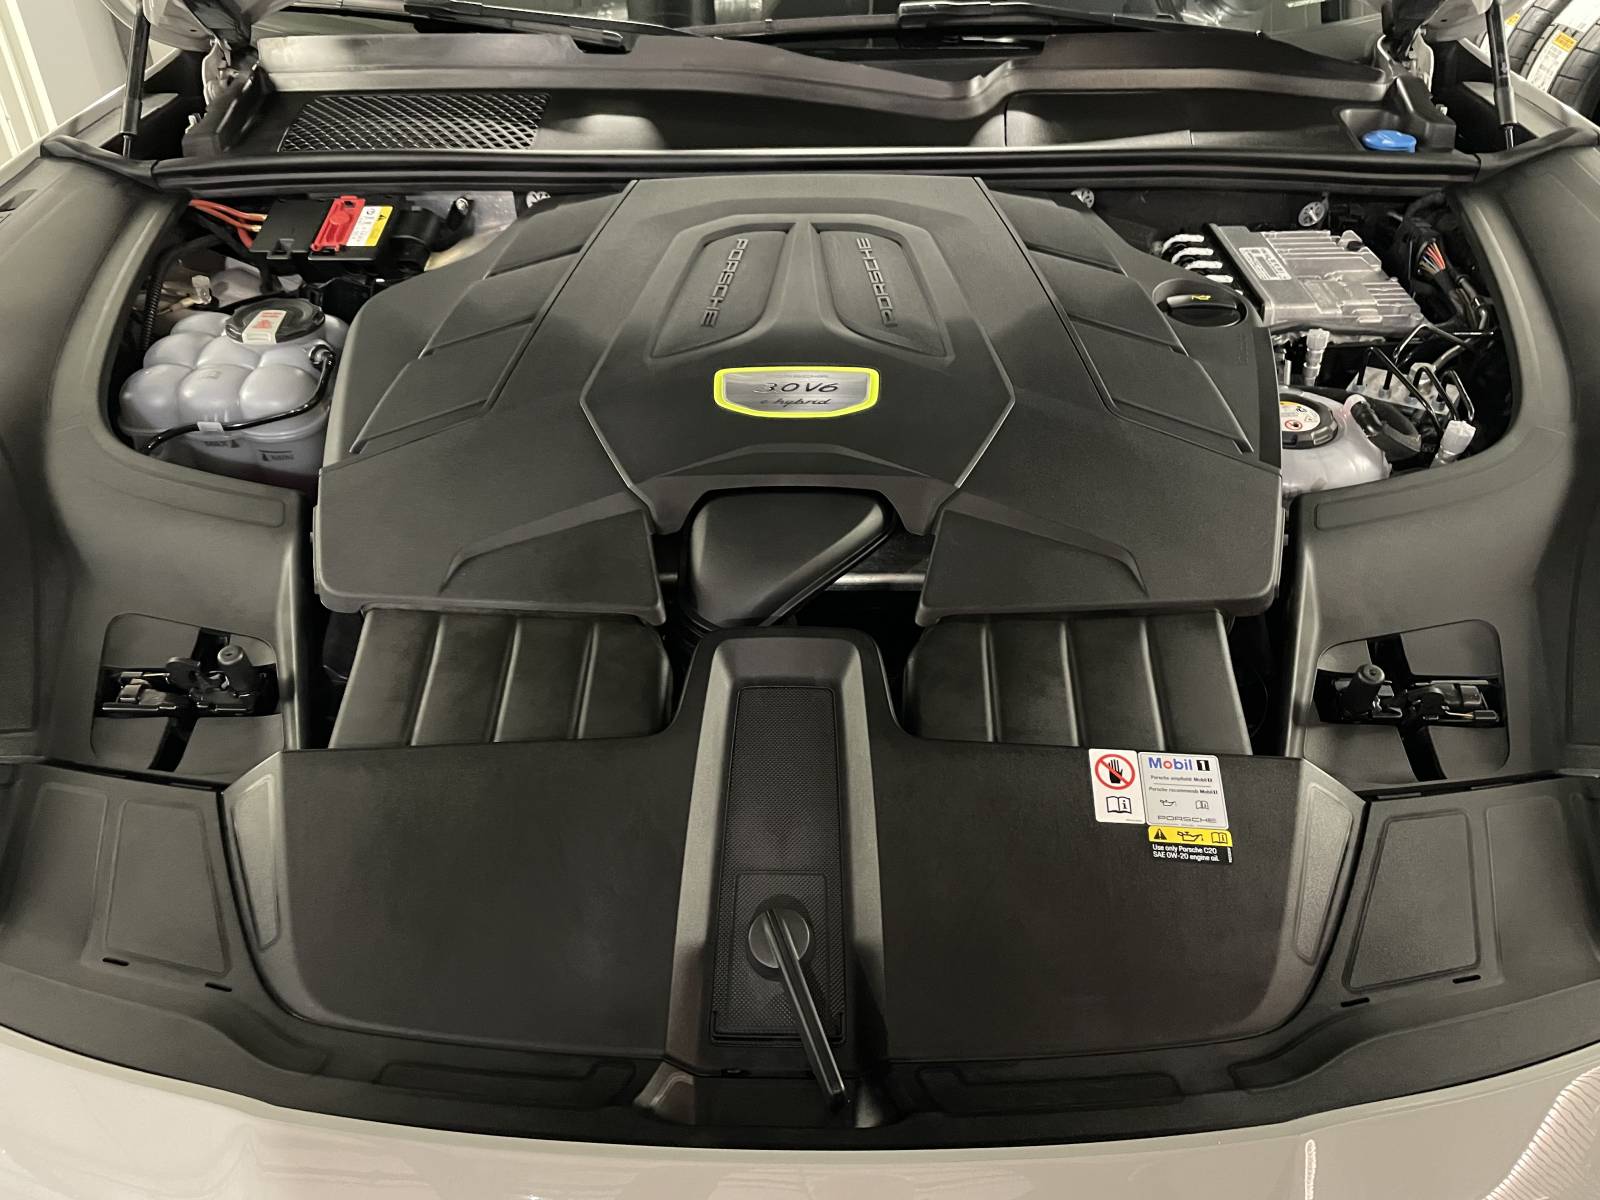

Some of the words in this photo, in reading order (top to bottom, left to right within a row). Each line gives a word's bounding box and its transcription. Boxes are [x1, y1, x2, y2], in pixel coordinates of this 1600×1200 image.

[701, 237, 749, 328] PORSCHE
[856, 237, 898, 328] PORSCHE
[806, 382, 839, 393] V6
[1148, 757, 1193, 770] Mobil
[1157, 815, 1217, 823] PORSCHE
[1152, 843, 1165, 851] Use
[1178, 845, 1203, 853] Porsche
[1166, 852, 1189, 860] 0W-20
[1189, 854, 1210, 862] engine
